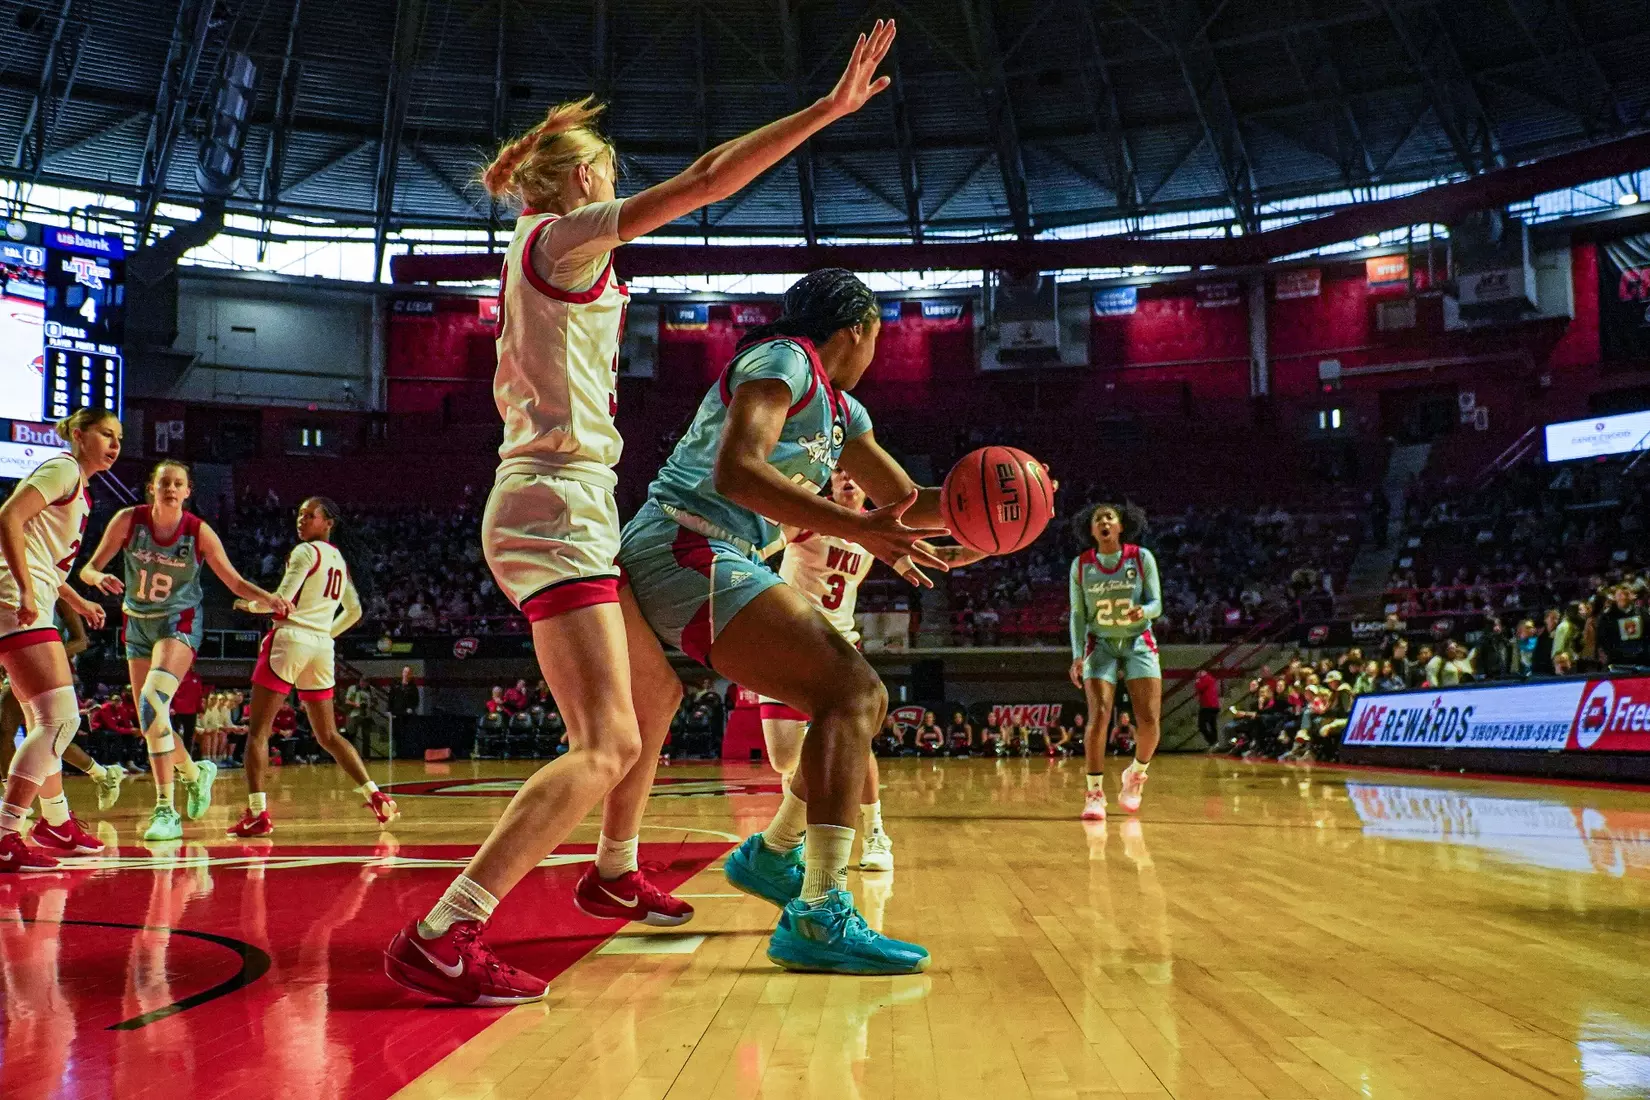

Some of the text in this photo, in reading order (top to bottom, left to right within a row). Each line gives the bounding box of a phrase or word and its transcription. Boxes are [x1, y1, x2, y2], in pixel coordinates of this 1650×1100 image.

[79, 296, 96, 323] 4
[924, 304, 961, 316] LIBERTY
[826, 545, 862, 576] WKU
[137, 569, 173, 602] 18
[323, 567, 342, 600] 10
[822, 575, 845, 610] 3
[1096, 599, 1133, 626] 23
[992, 704, 1063, 728] WKU
[1381, 704, 1473, 744] REWARDS
